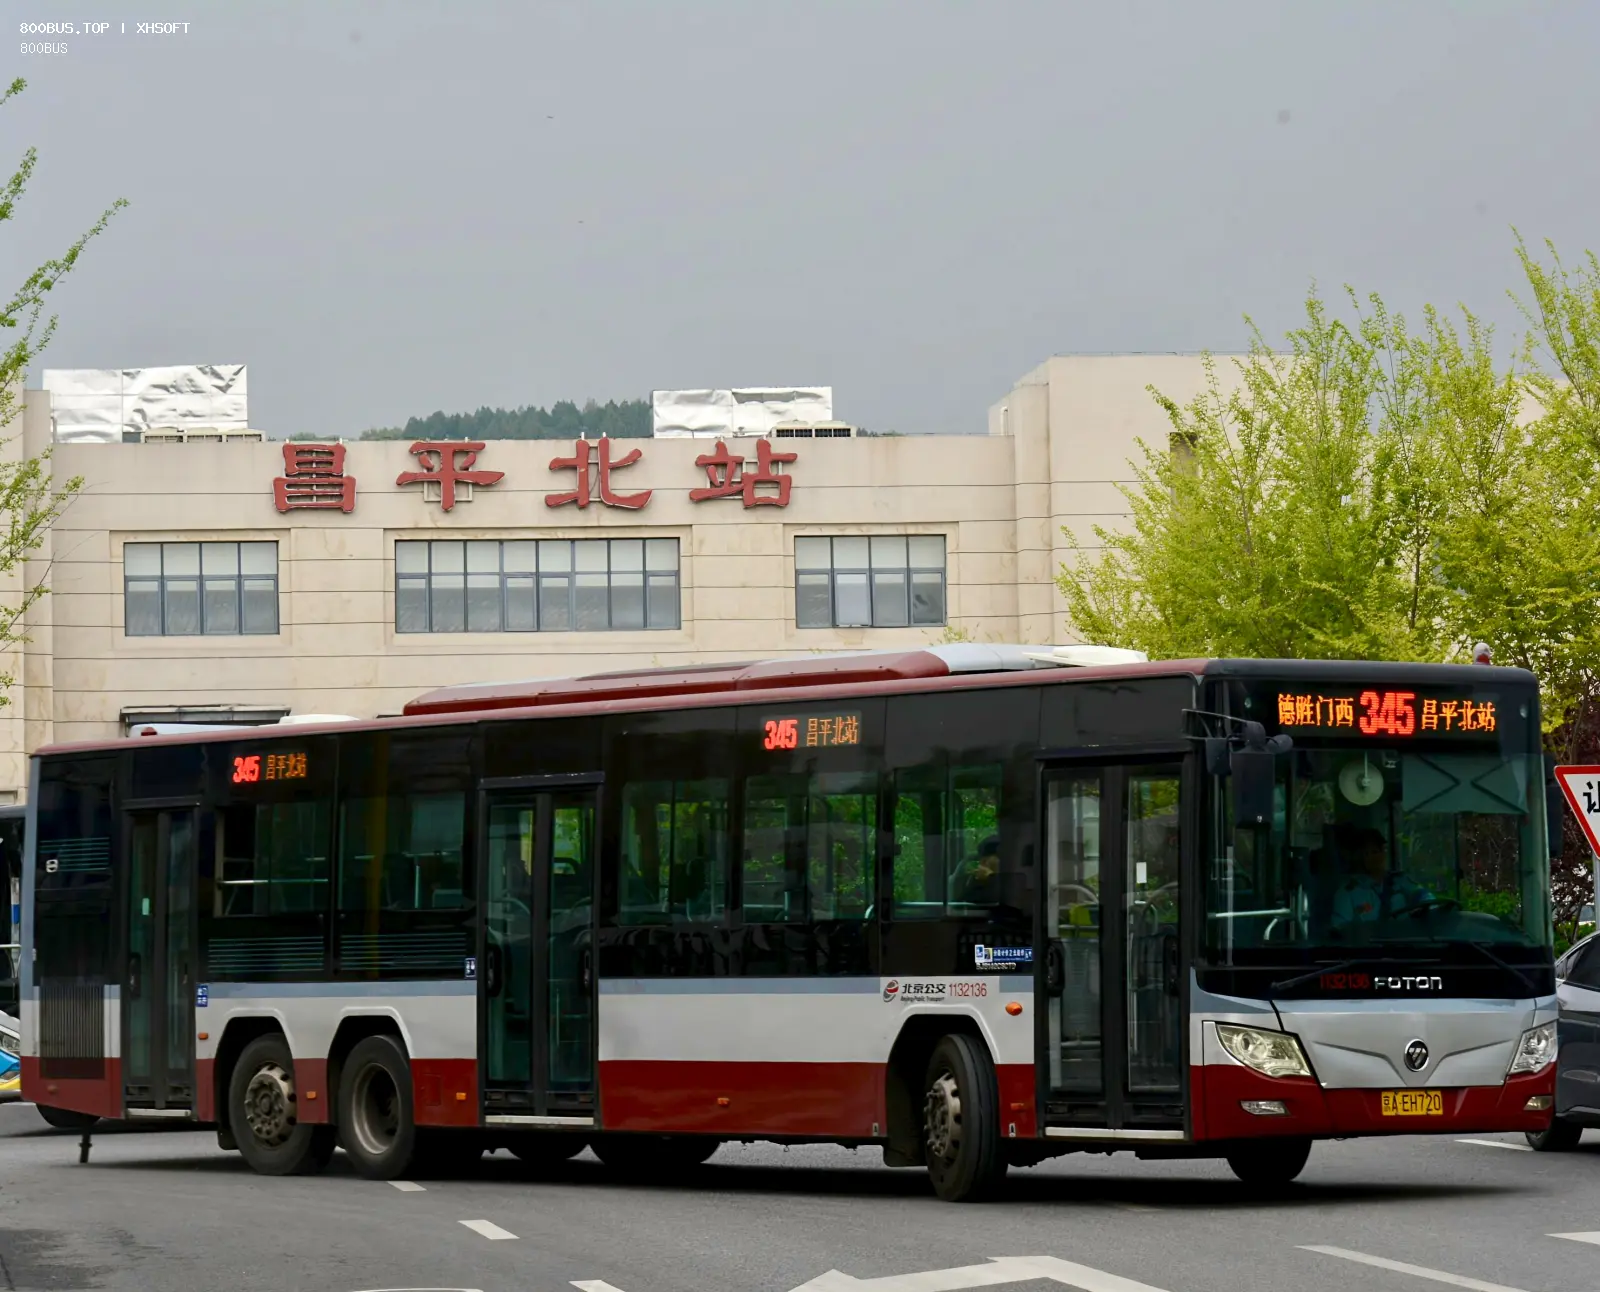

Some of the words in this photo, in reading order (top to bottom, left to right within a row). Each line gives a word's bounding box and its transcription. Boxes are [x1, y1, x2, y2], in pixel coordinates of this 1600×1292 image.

[272, 436, 799, 513] 昌平北站
[1278, 693, 1354, 727] 德胜门西
[1359, 691, 1416, 735] 345
[1421, 699, 1496, 732] 昌平北站
[764, 719, 798, 750] 345
[806, 715, 858, 747] 昌平北站
[902, 983, 946, 995] 北京公交
[949, 982, 987, 997] 1132136
[1374, 976, 1443, 990] FOTON
